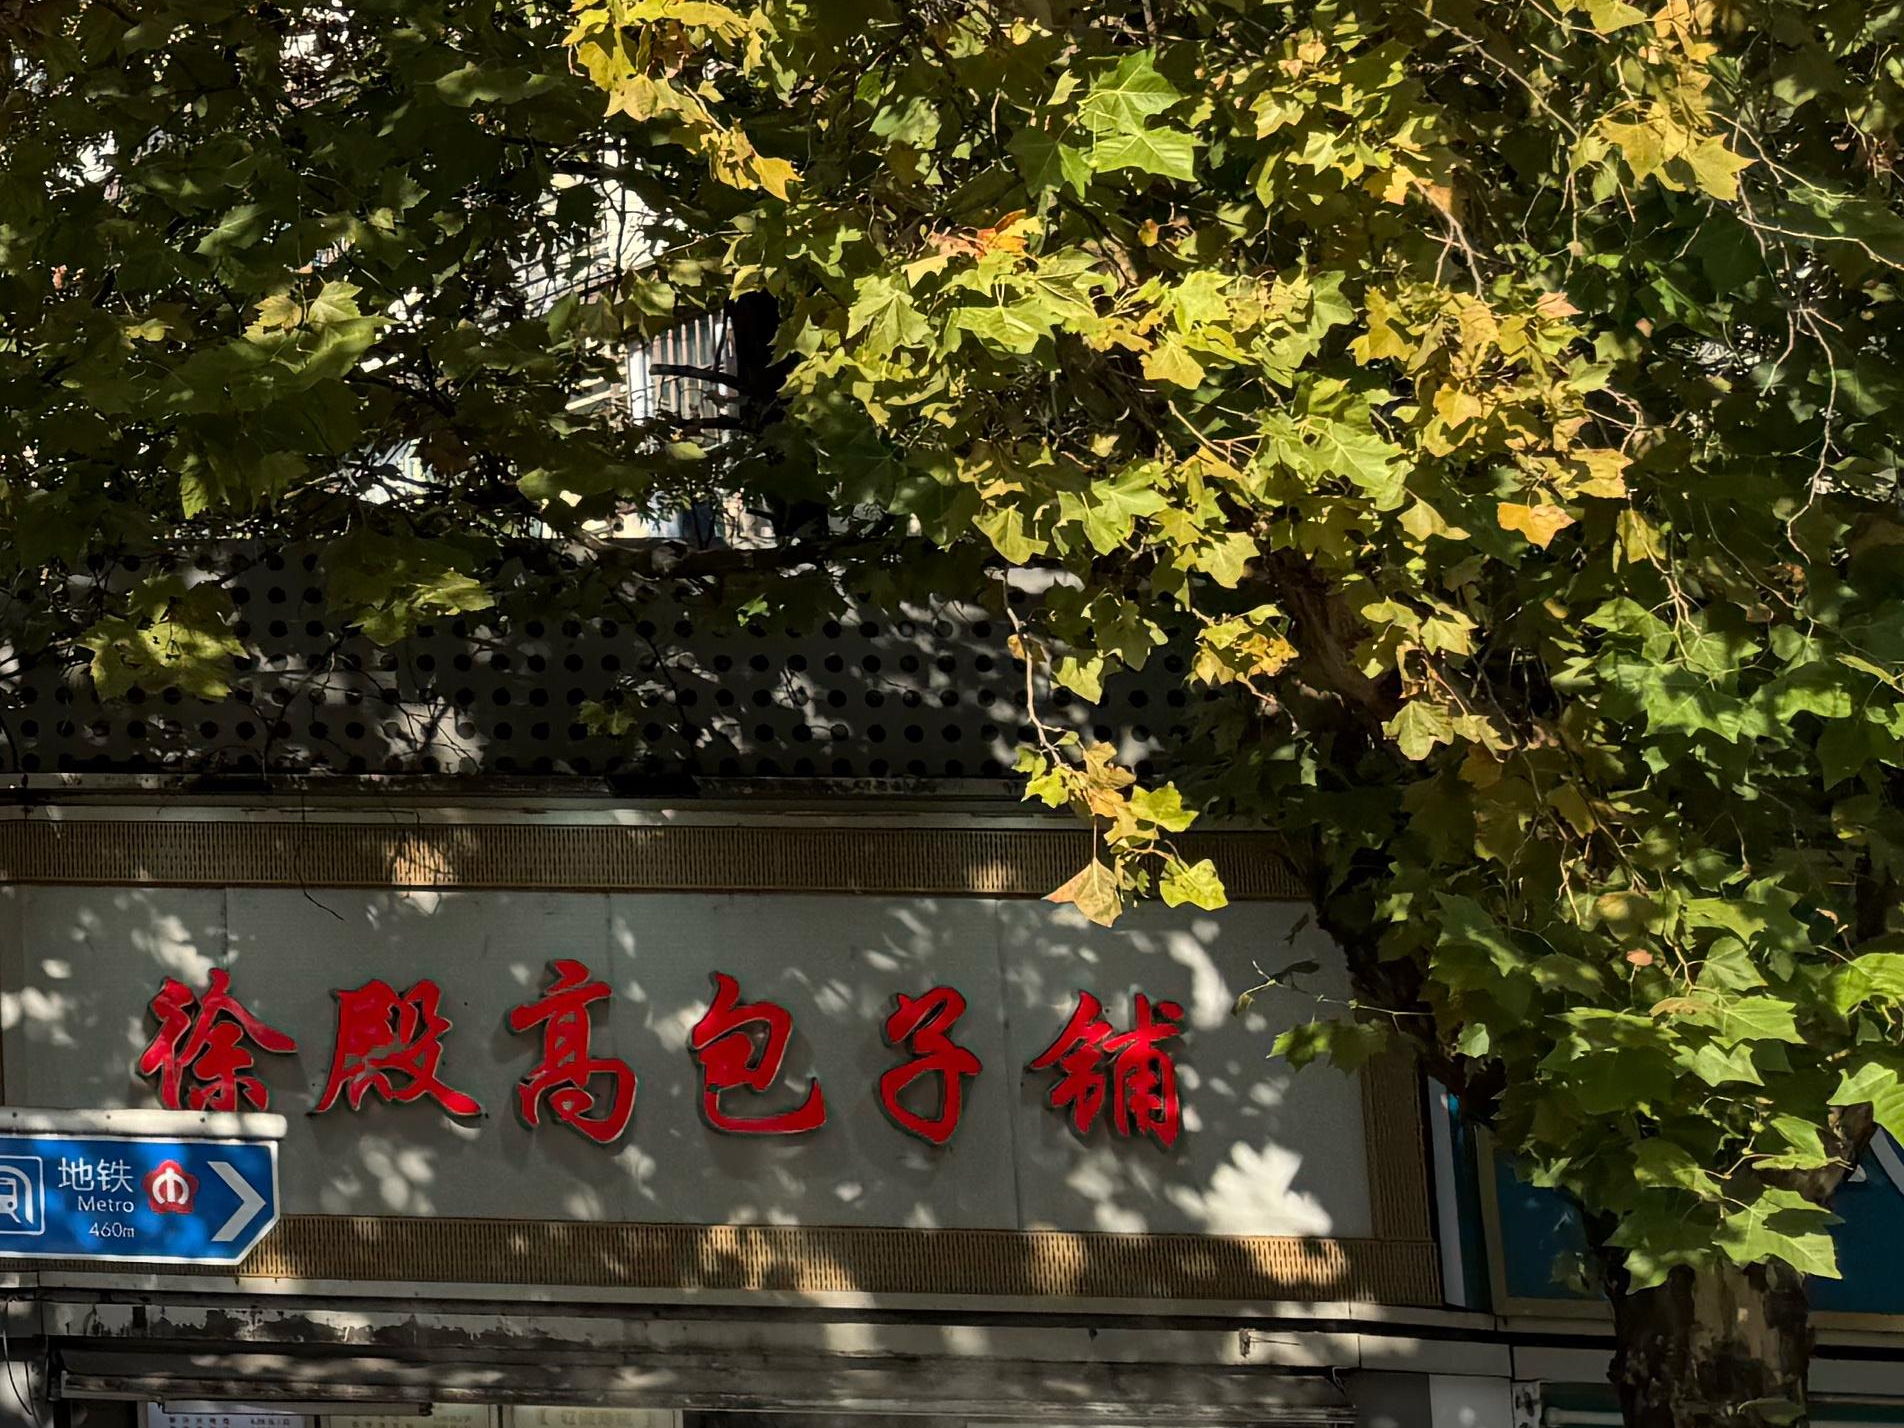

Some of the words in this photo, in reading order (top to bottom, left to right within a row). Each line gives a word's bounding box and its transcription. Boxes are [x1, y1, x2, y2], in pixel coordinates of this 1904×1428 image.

[136, 958, 1188, 1147] 徐殿高包子铺
[58, 1157, 134, 1194] 地铁
[77, 1195, 135, 1214] Metro
[88, 1221, 135, 1239] 460m
